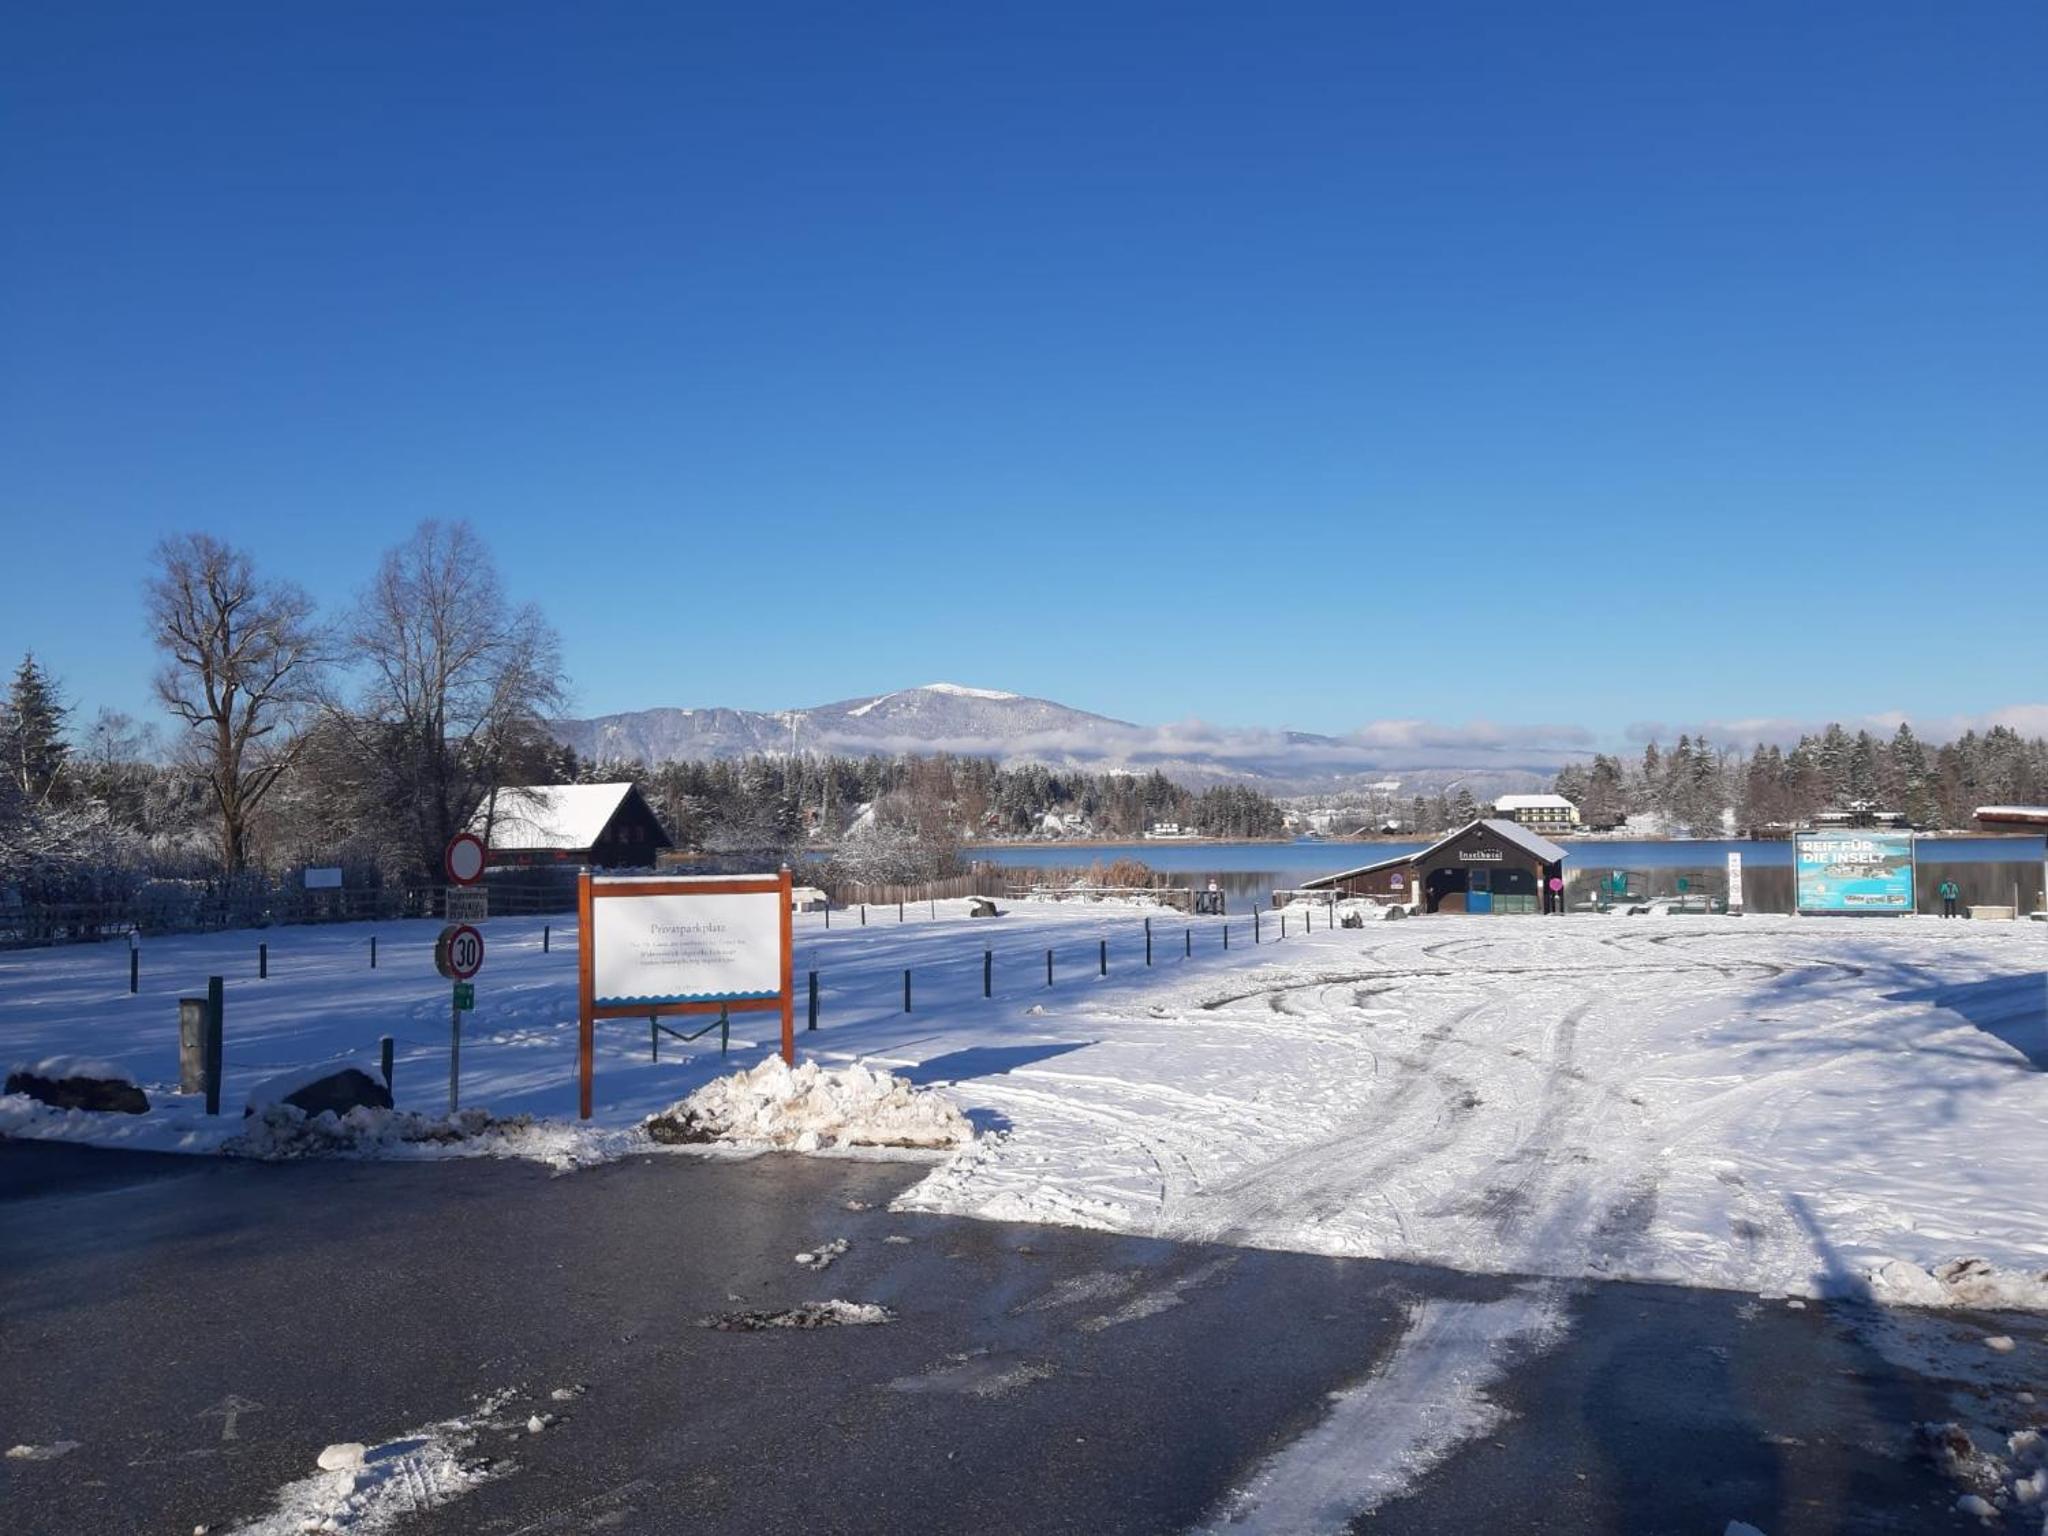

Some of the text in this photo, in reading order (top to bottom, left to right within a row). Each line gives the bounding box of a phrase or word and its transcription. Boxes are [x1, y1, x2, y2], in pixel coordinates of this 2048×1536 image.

[1802, 838, 1873, 852] REIF FÜR
[1803, 852, 1885, 863] DIE INSEL?
[651, 922, 726, 937] Privatparkplatz
[456, 939, 476, 967] 30
